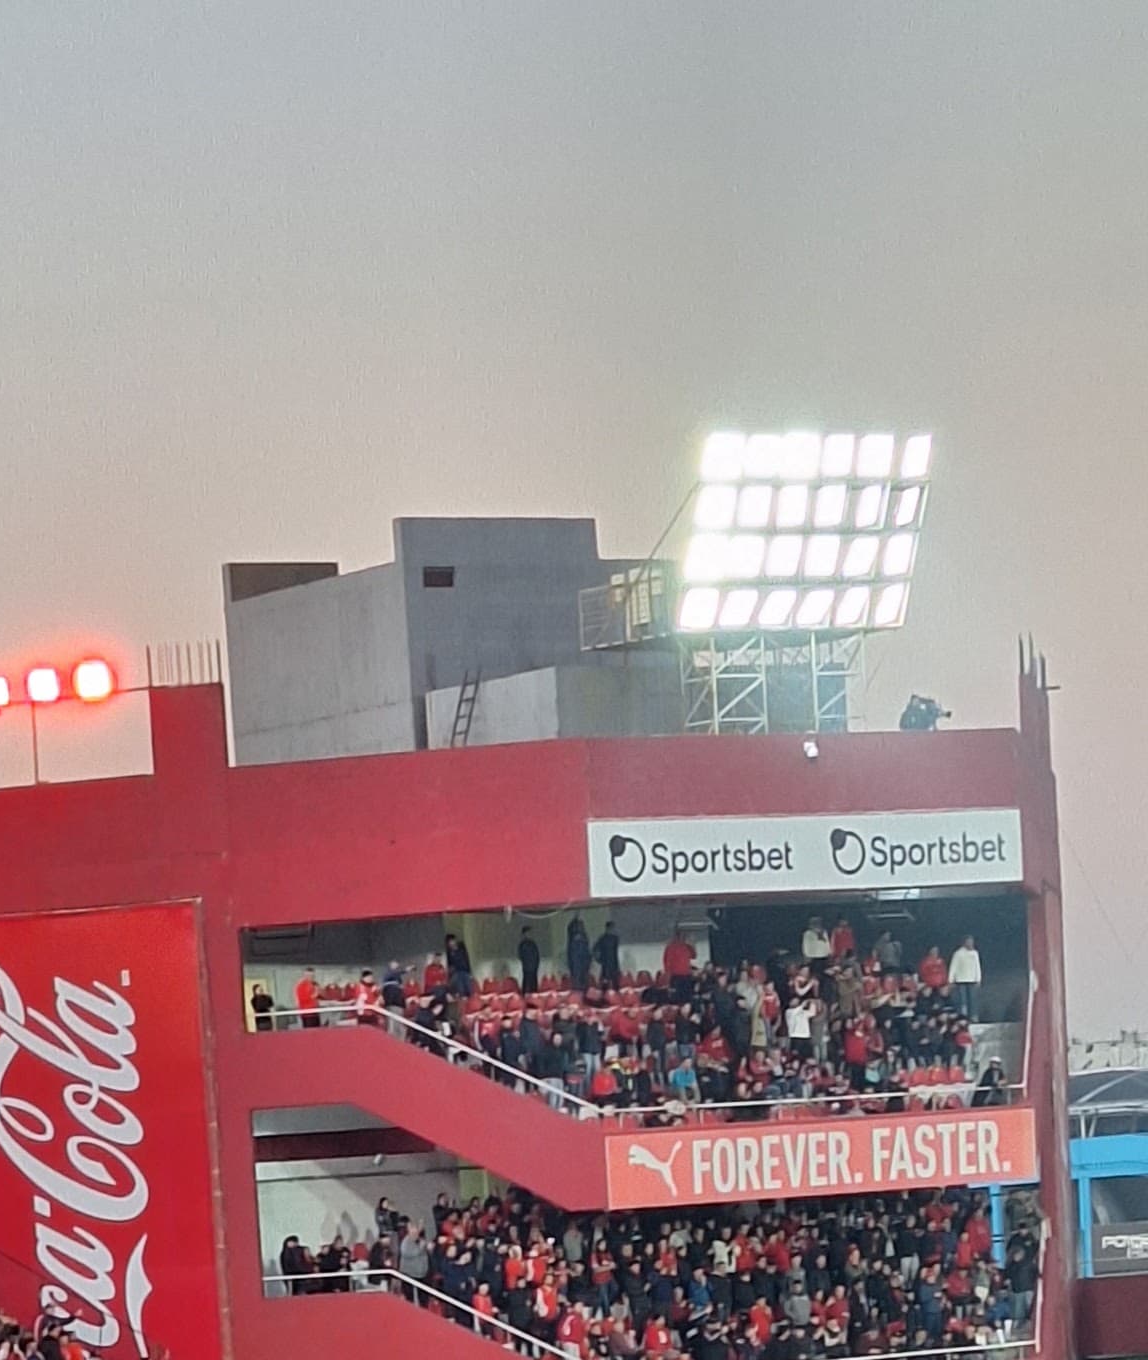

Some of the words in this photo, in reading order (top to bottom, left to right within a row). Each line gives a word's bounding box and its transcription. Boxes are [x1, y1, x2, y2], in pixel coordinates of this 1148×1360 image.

[651, 841, 793, 881] Sportsbet
[872, 832, 1006, 874] Sportsbet
[691, 1131, 864, 1194] FOREVER.
[872, 1119, 1012, 1181] FASTER.
